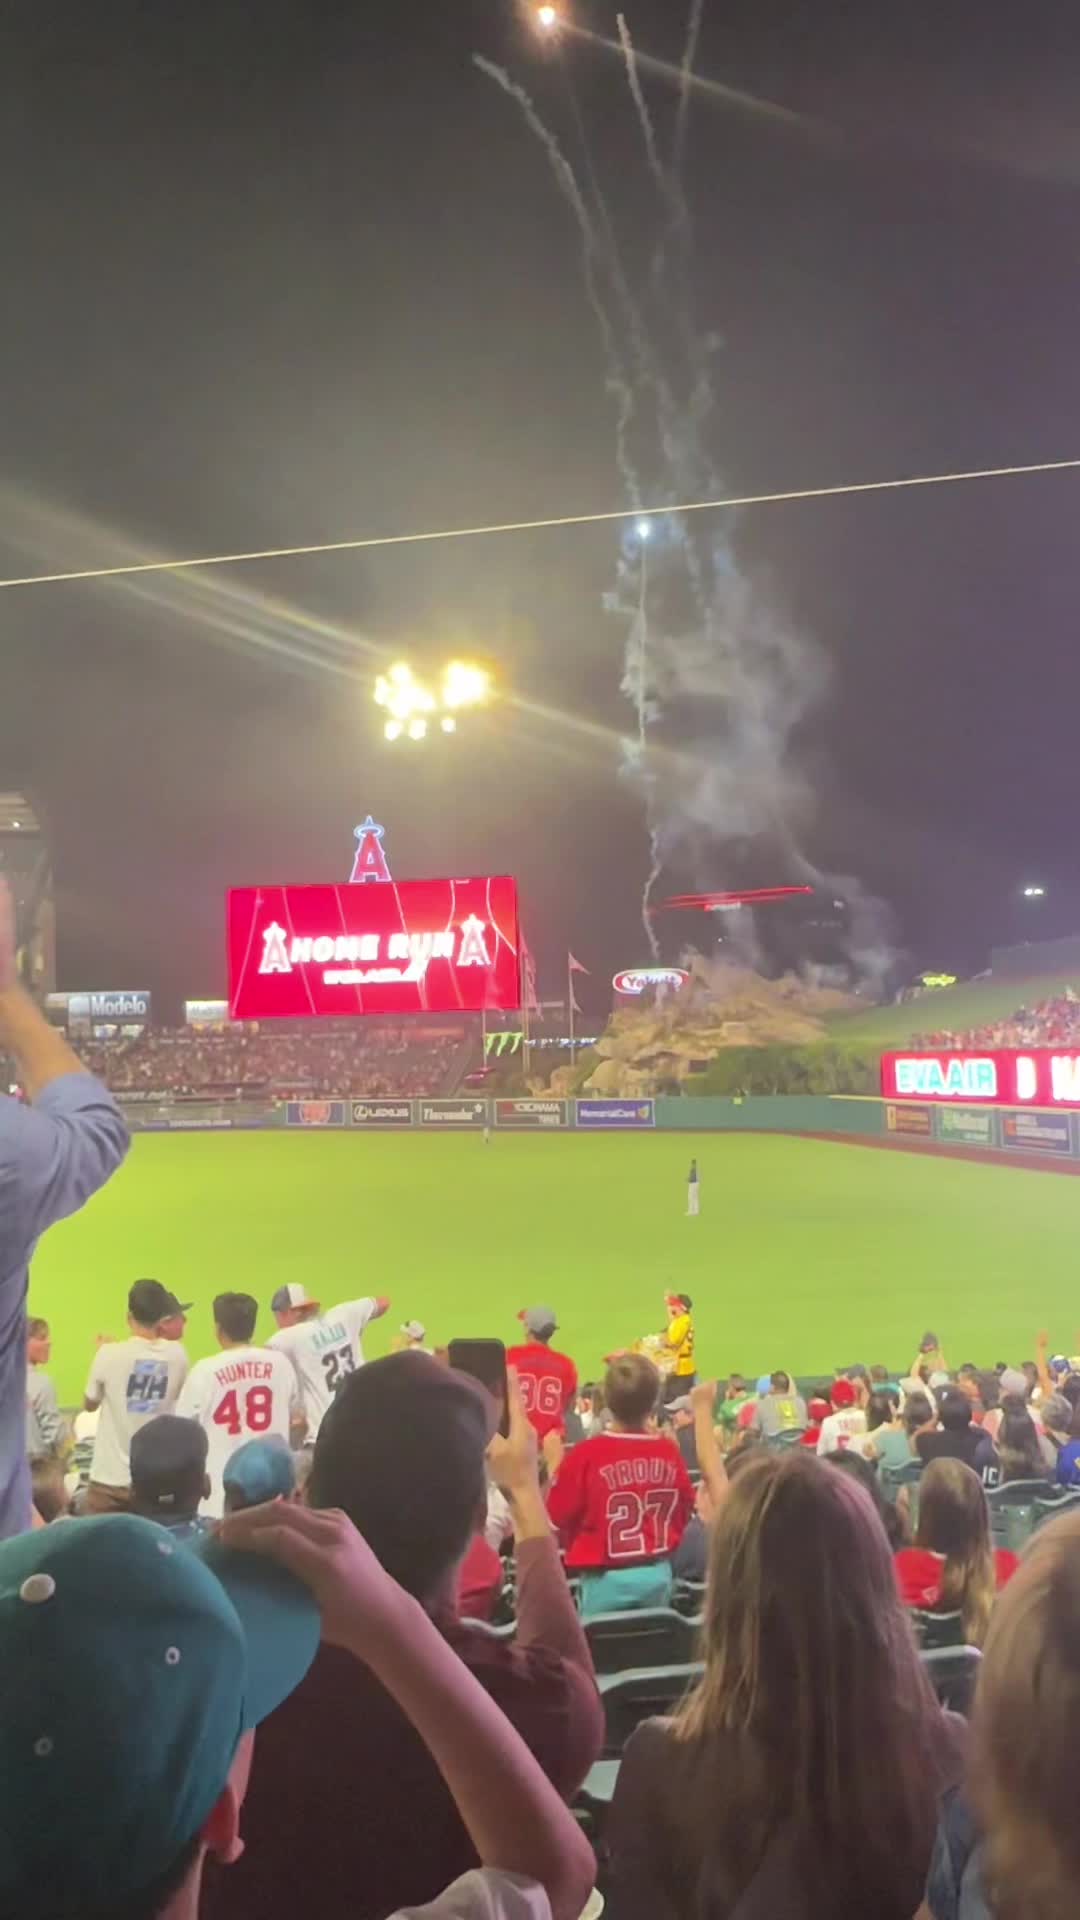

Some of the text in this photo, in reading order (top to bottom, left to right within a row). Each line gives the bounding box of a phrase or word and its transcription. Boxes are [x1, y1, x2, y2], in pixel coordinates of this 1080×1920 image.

[349, 816, 392, 882] A
[290, 935, 380, 962] HOME
[388, 932, 455, 960] RUN
[91, 996, 147, 1016] Modelo
[215, 1361, 273, 1385] HUNTER
[213, 1385, 273, 1435] 48
[600, 1457, 679, 1490] TROUT
[606, 1489, 680, 1558] 27
